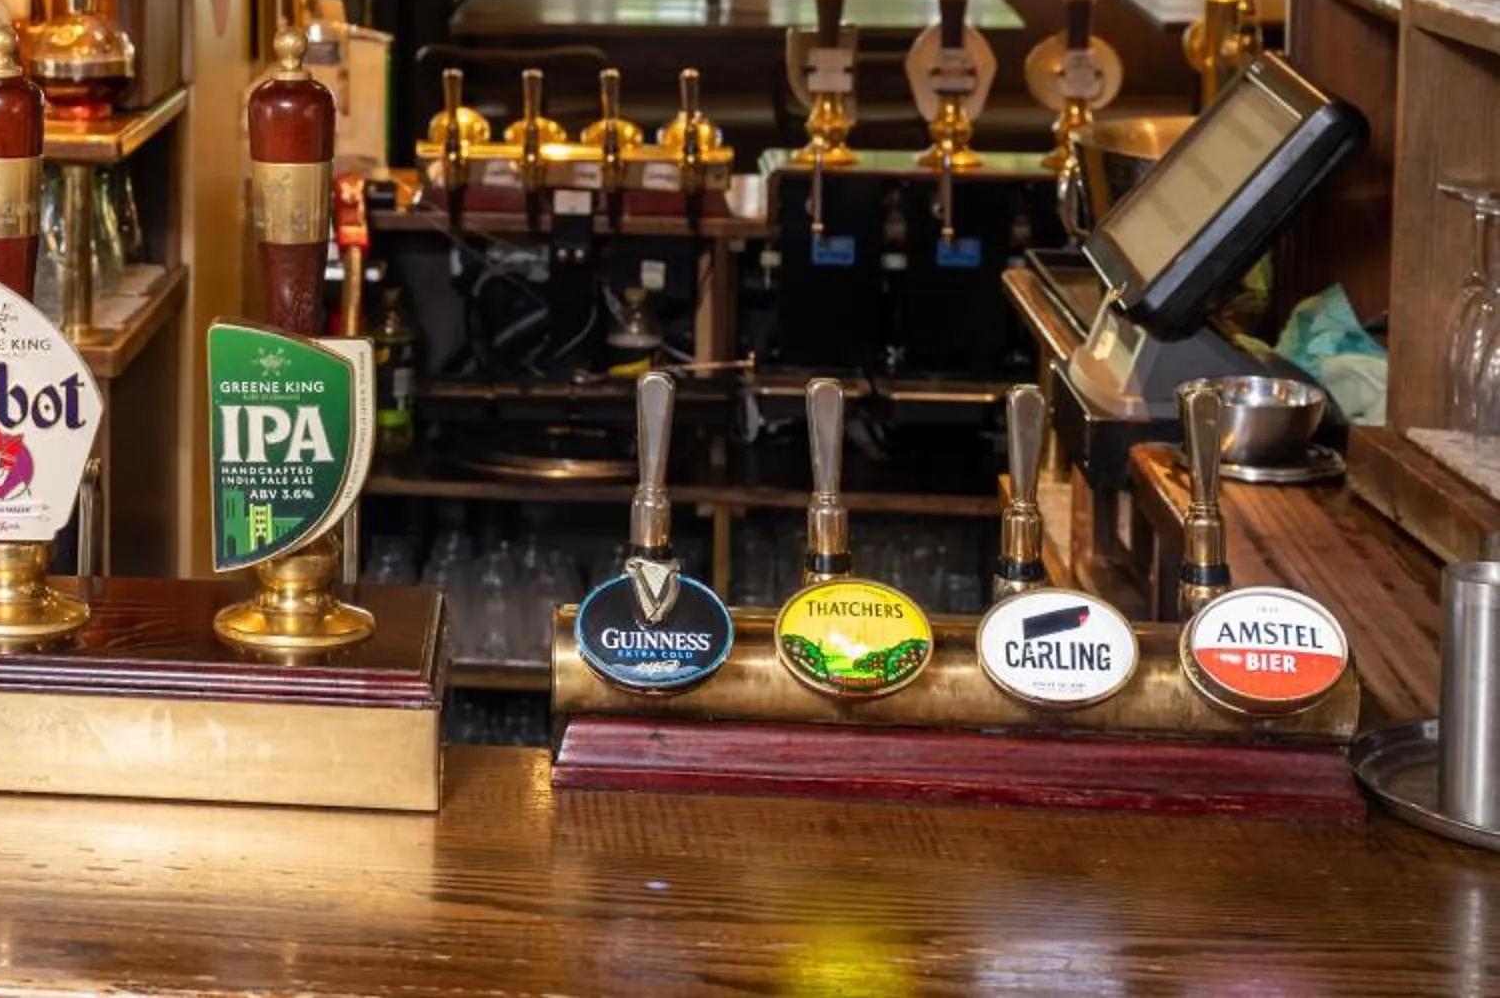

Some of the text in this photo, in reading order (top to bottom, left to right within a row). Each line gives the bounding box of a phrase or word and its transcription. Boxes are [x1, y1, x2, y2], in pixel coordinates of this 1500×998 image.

[11, 338, 52, 352] KING
[220, 381, 325, 393] GREENE KING
[219, 405, 335, 463] IPA
[221, 465, 314, 475] HANDCRAFTED
[221, 476, 314, 485] INDIA PALE ALE
[249, 488, 278, 500] ABV
[806, 600, 904, 619] THATCHERS
[601, 628, 712, 651] GUINNESS
[1217, 621, 1324, 649] AMSTEL
[617, 650, 694, 659] EXTRA COLD
[1005, 641, 1112, 671] CARLING
[1245, 652, 1297, 674] BIER
